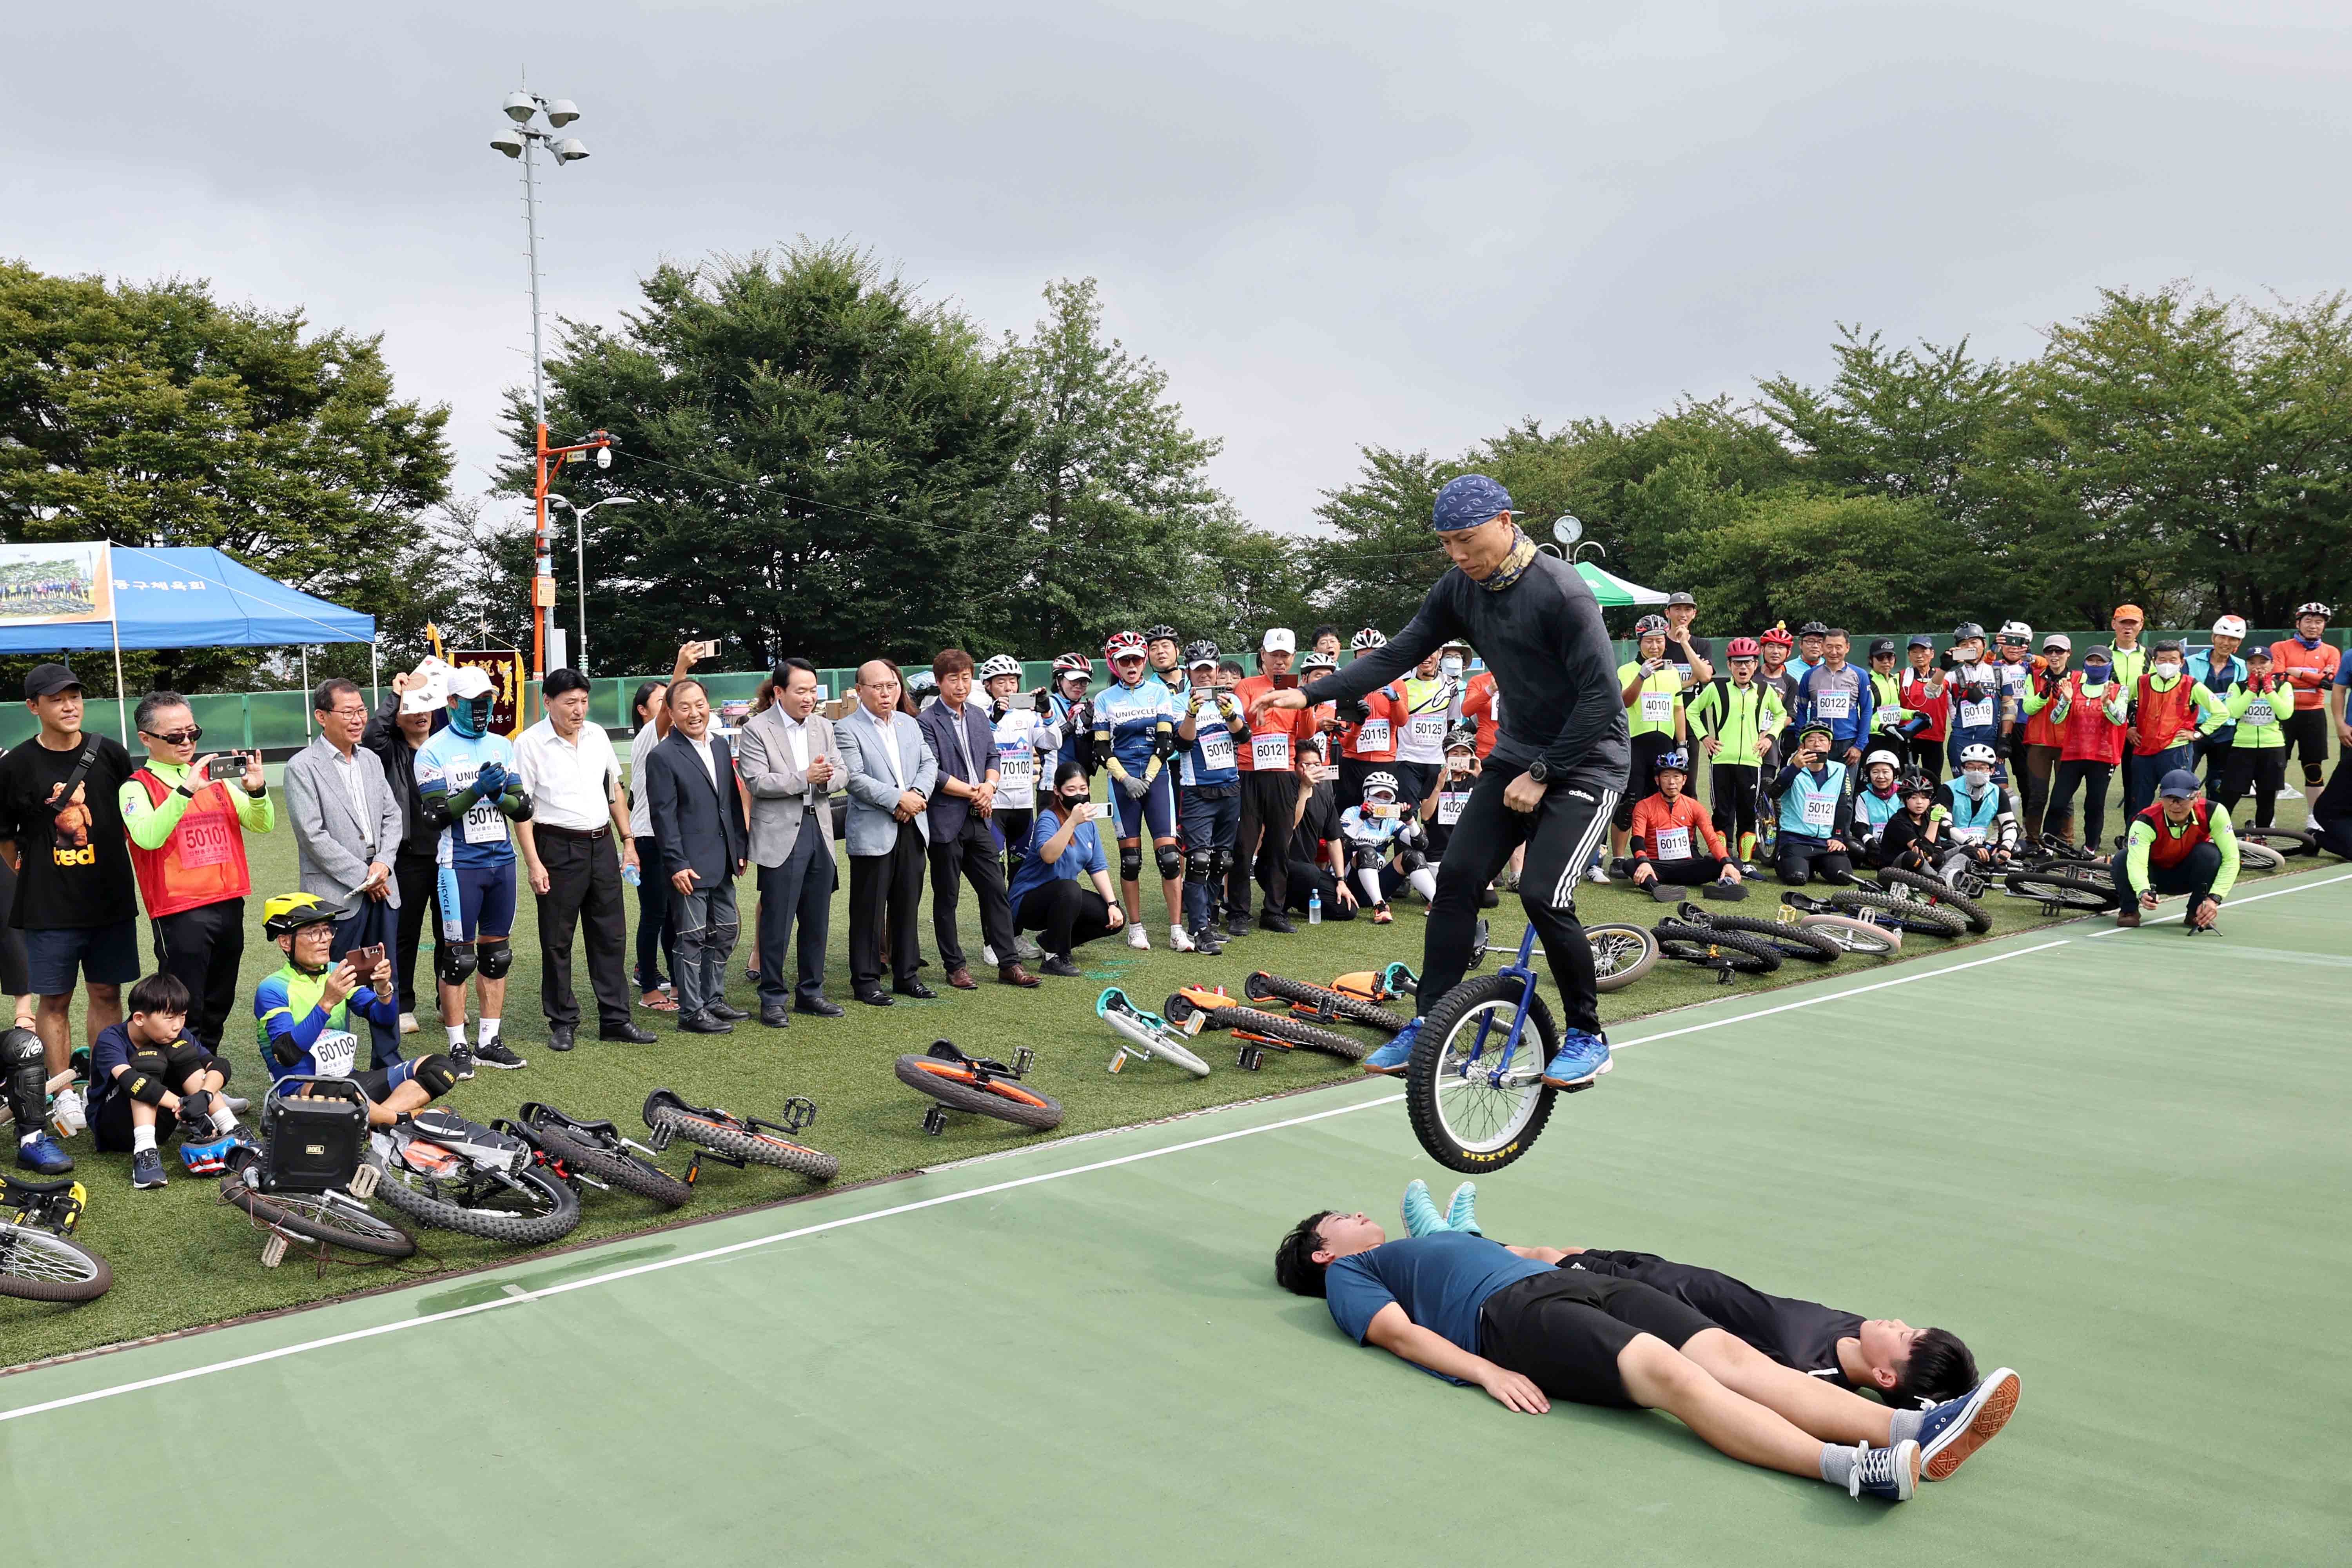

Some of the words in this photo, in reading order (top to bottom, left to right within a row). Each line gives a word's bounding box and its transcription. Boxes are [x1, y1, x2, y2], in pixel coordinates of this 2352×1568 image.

[1646, 700, 1670, 711] 40101
[1820, 698, 1846, 708] 60122
[1115, 708, 1155, 718] UNICYCLE
[1964, 705, 1991, 717] 60118
[1359, 728, 1387, 740] 50115
[1415, 723, 1442, 735] 50125
[1207, 741, 1232, 757] 50124
[1257, 744, 1286, 757] 60121
[1002, 761, 1030, 775] 70103
[1568, 790, 1594, 802] adidas
[1443, 802, 1466, 813] 4020
[1808, 802, 1834, 814] 50121
[185, 825, 227, 849] 50101
[1660, 836, 1688, 850] 60119
[53, 843, 95, 866] ted
[317, 1036, 355, 1062] 60109
[1462, 1141, 1519, 1161] MAXXIS
